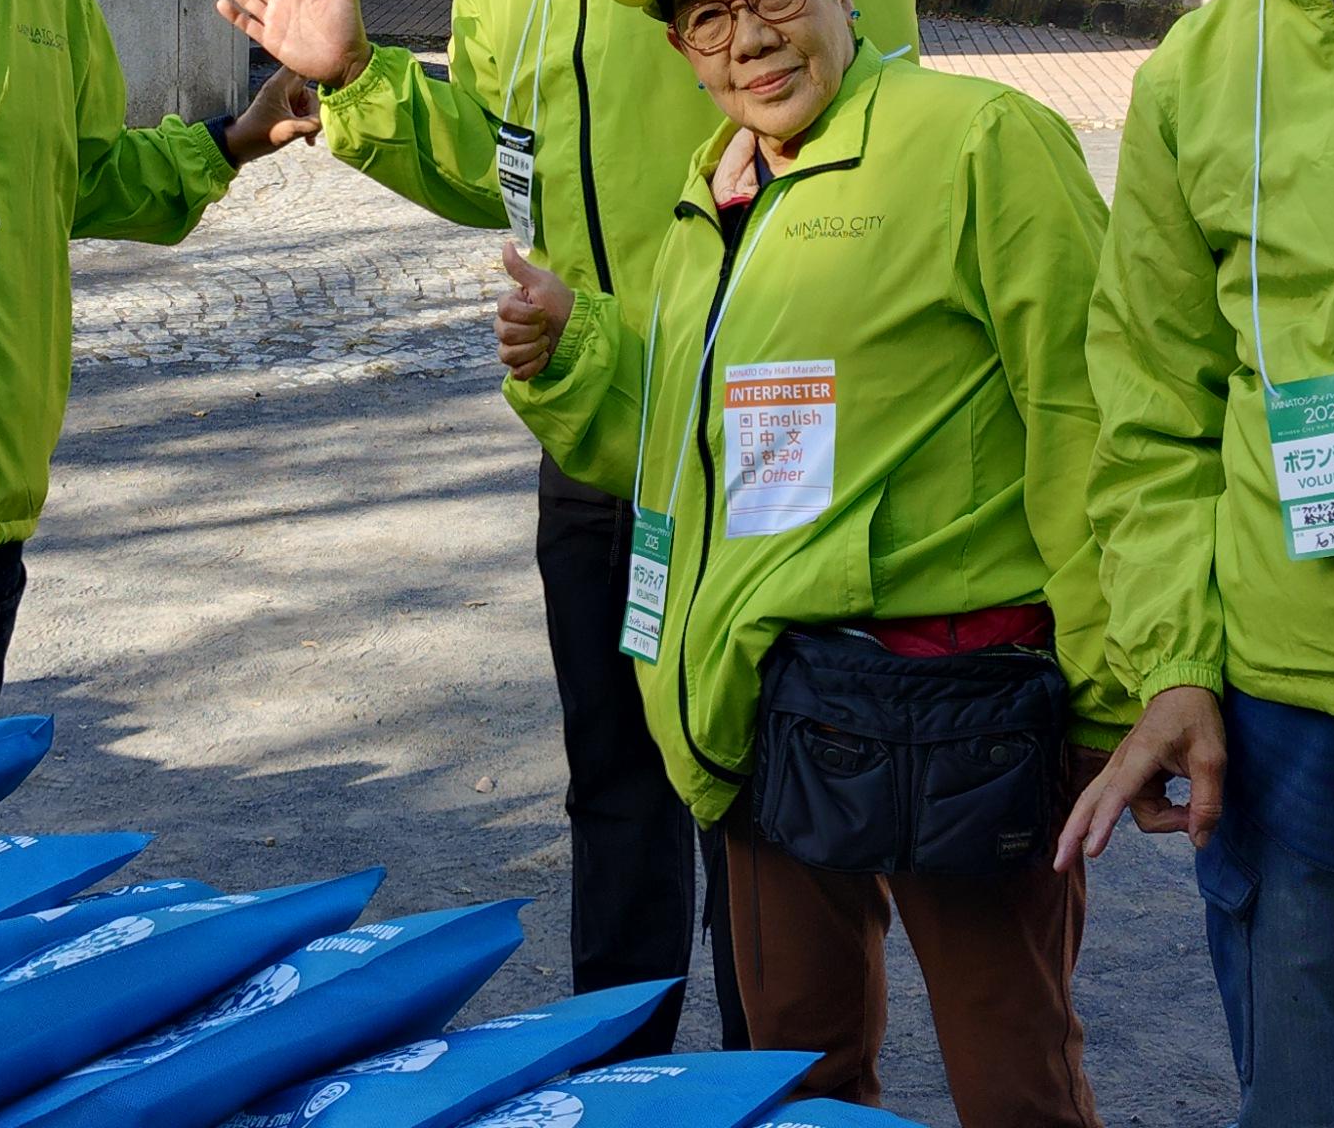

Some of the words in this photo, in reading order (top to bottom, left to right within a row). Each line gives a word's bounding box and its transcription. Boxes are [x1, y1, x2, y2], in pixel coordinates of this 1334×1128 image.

[785, 217, 844, 239] MINATO
[850, 215, 886, 230] CITY
[792, 365, 833, 374] Marathon
[730, 383, 831, 402] INTERPRETER
[758, 409, 822, 428] English
[761, 448, 803, 466] 한국어
[762, 469, 805, 484] Other
[306, 937, 376, 954] MINATO
